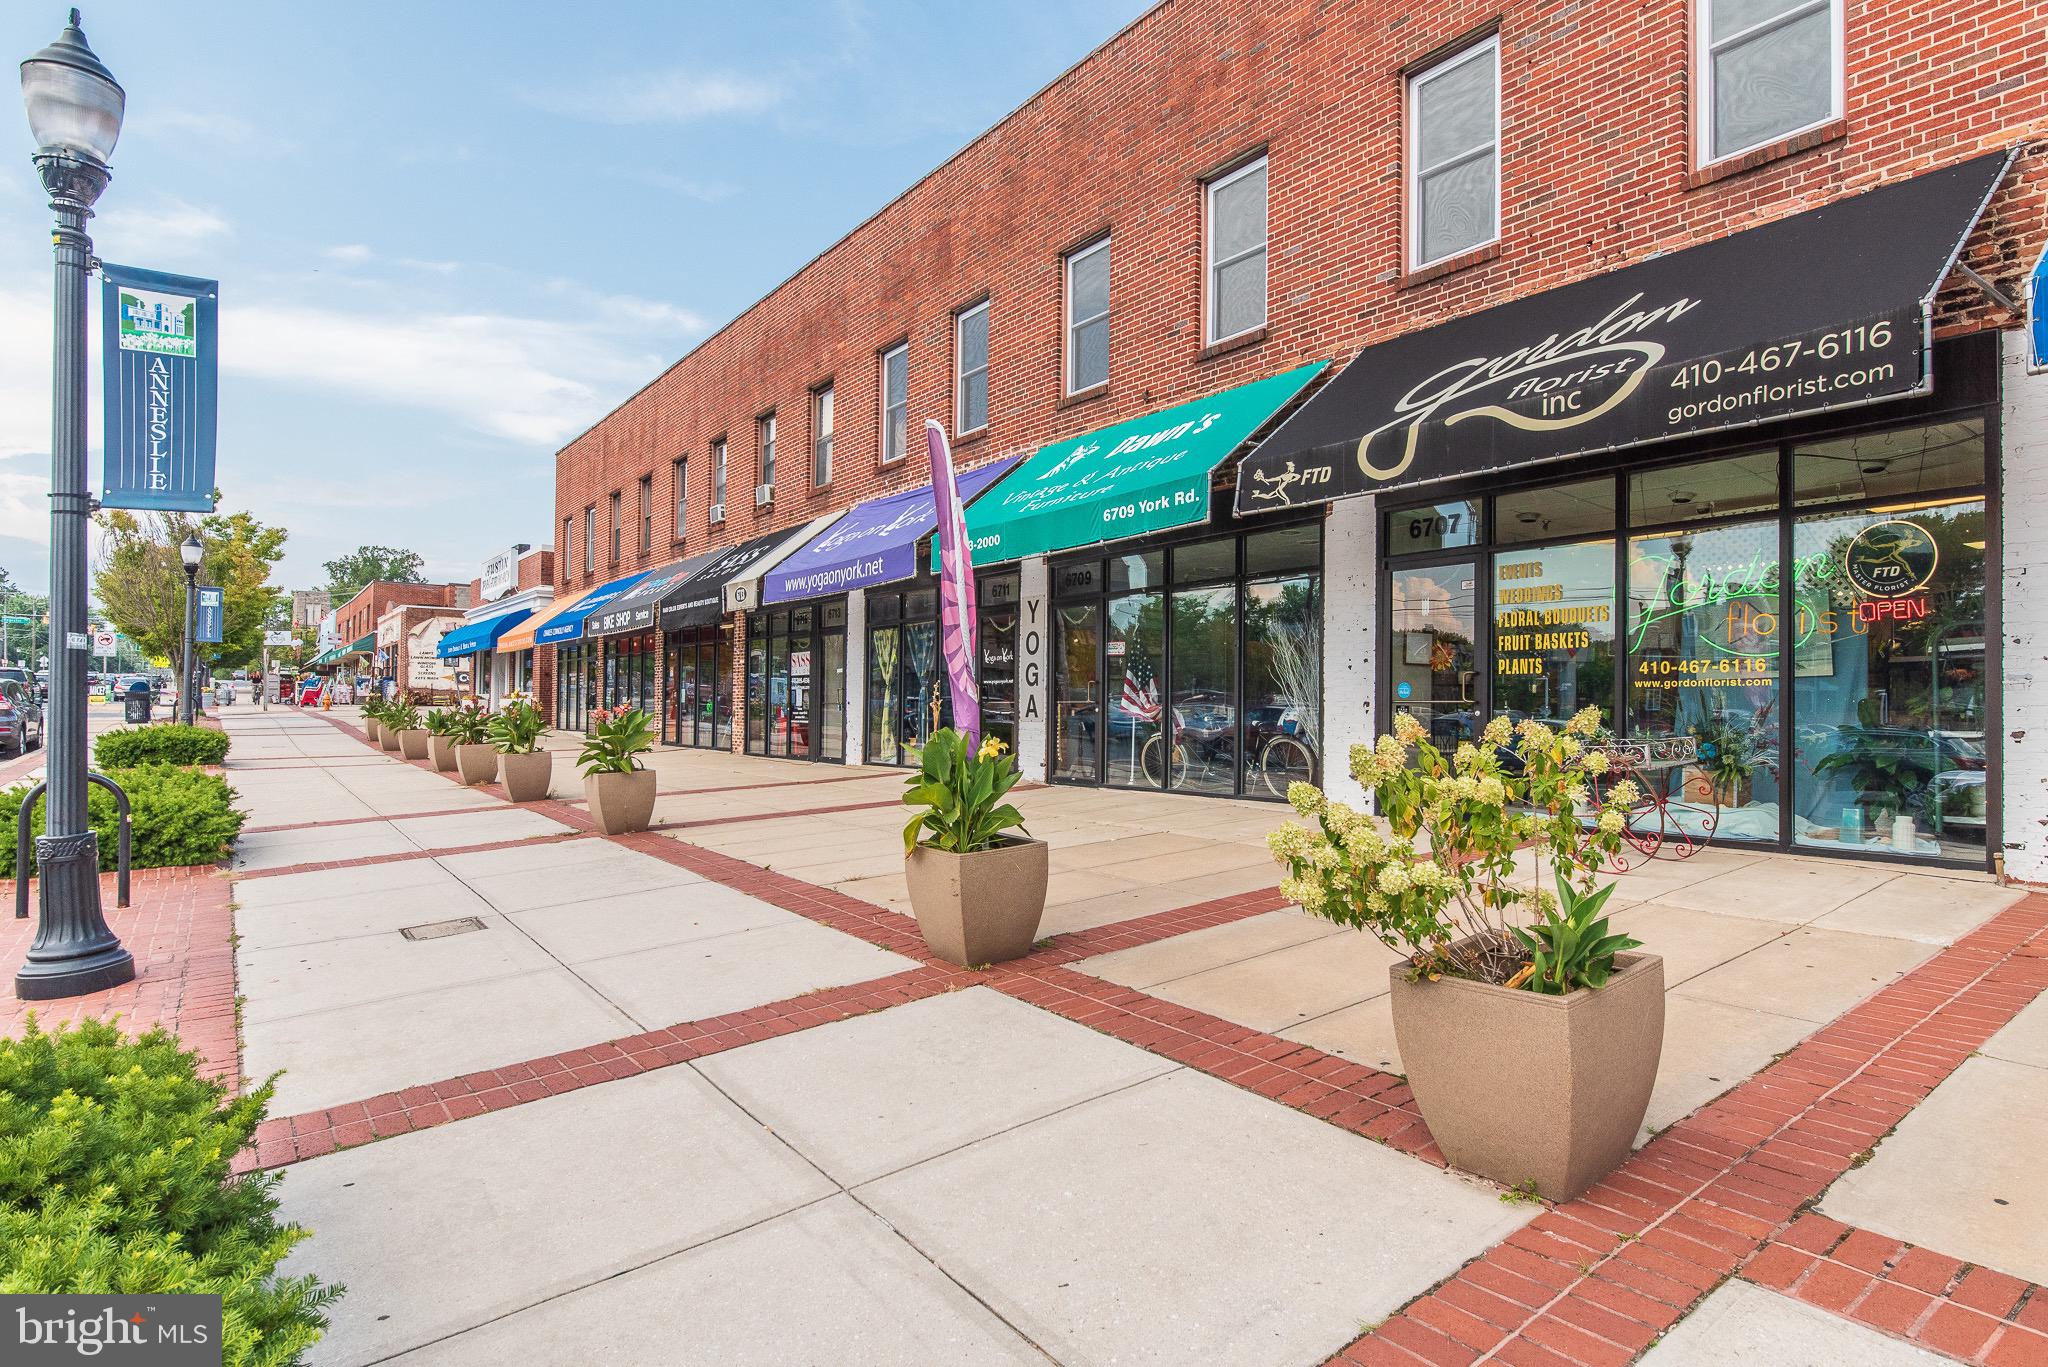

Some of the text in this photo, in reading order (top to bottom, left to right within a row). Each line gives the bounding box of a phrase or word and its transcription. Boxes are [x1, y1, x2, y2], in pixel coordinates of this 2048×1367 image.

[1670, 320, 1893, 390] 410-467-6116
[1357, 292, 1701, 480] gordon
[1507, 355, 1636, 400] florist
[1541, 389, 1582, 417] inc
[1667, 361, 1894, 424] gordonflorist.com
[148, 356, 170, 491] ANNESLIE
[1072, 470, 1099, 488] &
[1300, 465, 1333, 485] FTD
[1103, 488, 1200, 521] 6709 York Rd.
[812, 522, 860, 552] Yoga
[1409, 513, 1462, 538] 6707
[785, 557, 884, 593] www.yogaonyork.net
[1065, 571, 1092, 587] 6709
[1498, 561, 1543, 580] EVENTS
[1852, 564, 1909, 592] MASTER FLORIST
[1872, 566, 1900, 578] FTD
[992, 583, 1010, 598] 6711
[1498, 584, 1564, 604] WEDDINGS
[603, 614, 615, 630] BIKE
[615, 610, 631, 628] SHOP
[1498, 605, 1610, 628] FLORAL BOUQUETS
[1727, 597, 1869, 644] floist
[1860, 599, 1925, 622] OPEN
[1498, 631, 1589, 652] FRUIT BASKETS
[1025, 599, 1040, 719] YOGA
[1498, 657, 1543, 675] PLANTS
[1639, 658, 1767, 675] 410-467-6116
[1634, 677, 1773, 690] www.gordonflorist.com
